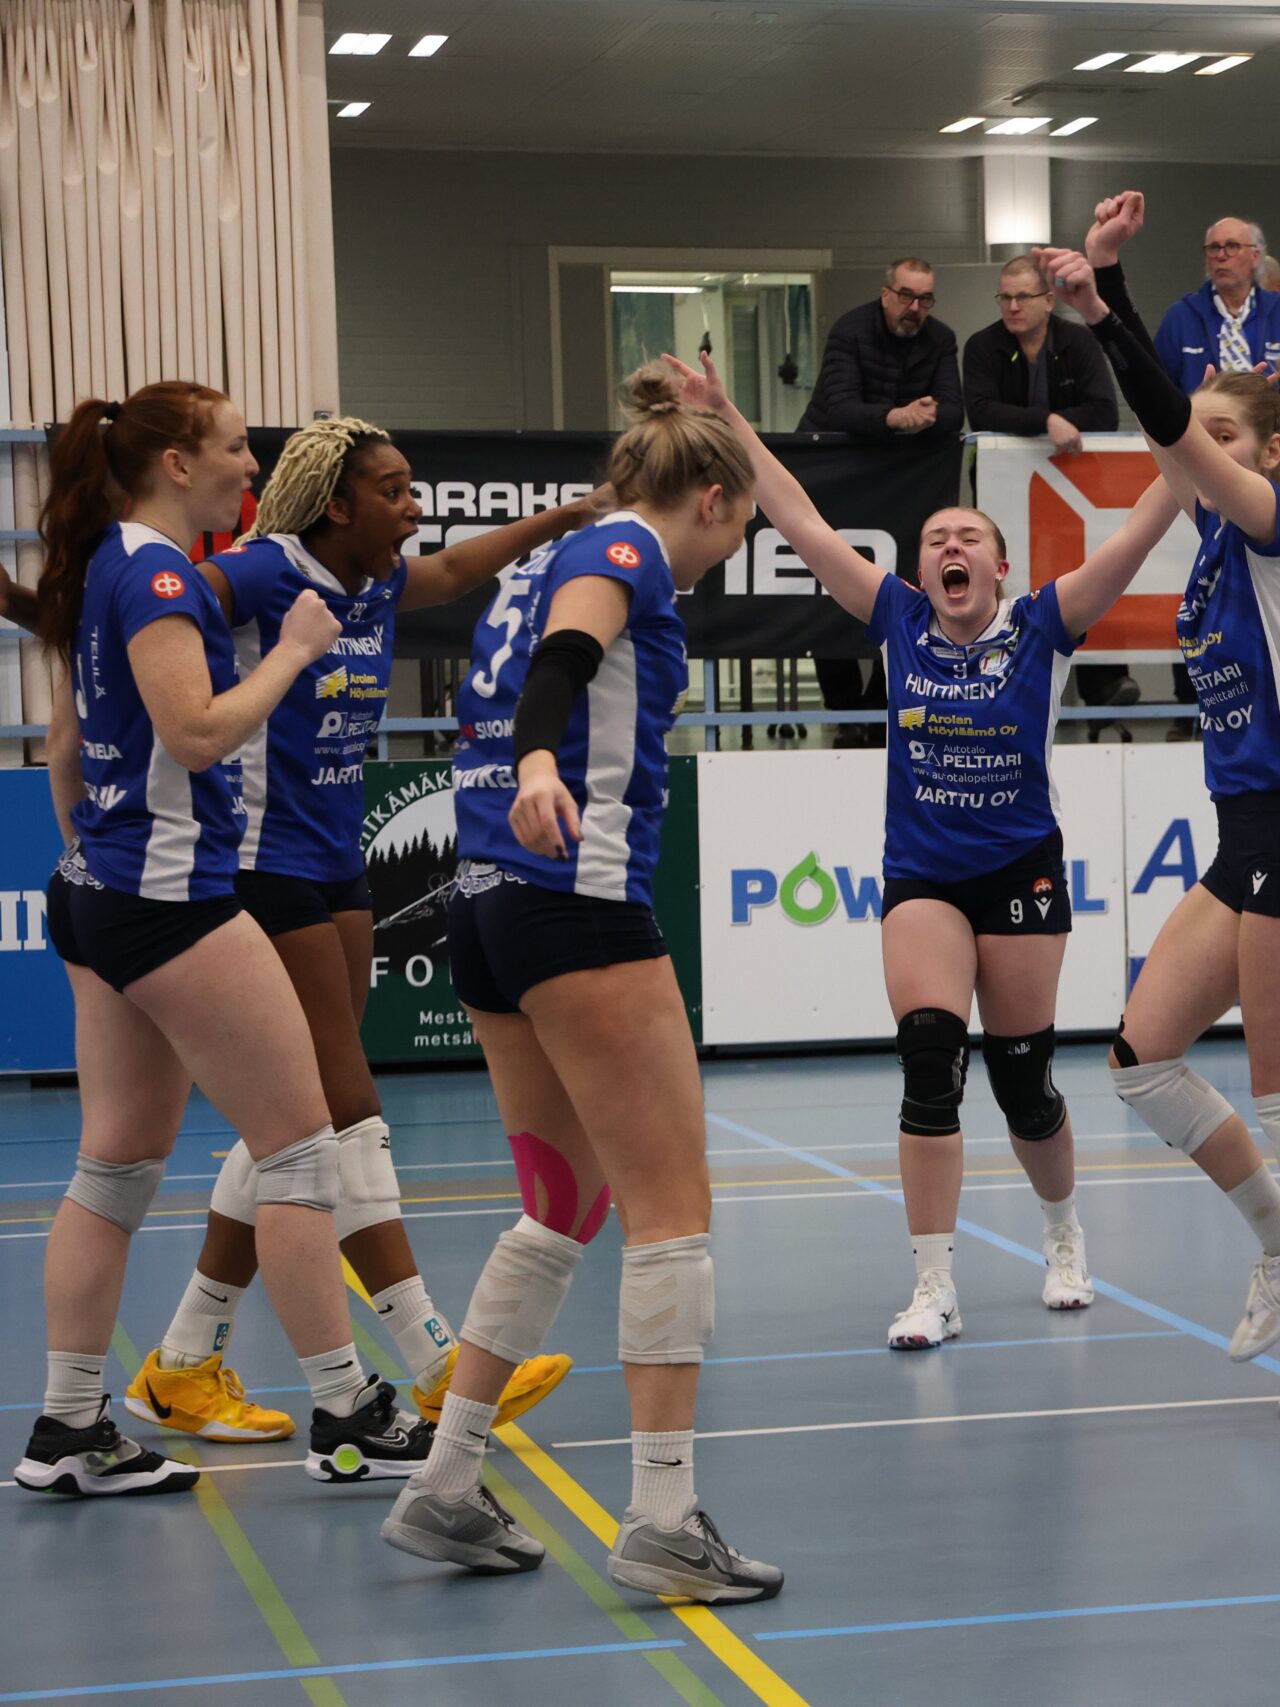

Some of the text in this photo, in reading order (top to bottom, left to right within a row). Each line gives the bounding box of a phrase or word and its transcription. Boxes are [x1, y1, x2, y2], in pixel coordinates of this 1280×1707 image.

[471, 579, 532, 699] 5
[905, 673, 996, 700] HUITTINEN
[928, 713, 973, 725] Arolan
[1226, 704, 1253, 729] OY
[928, 725, 1018, 737] Höyläämö Oy
[943, 744, 986, 755] Autotalo
[943, 753, 1022, 769] PELTTARI
[990, 789, 1020, 807] OY
[1009, 898, 1024, 924] 9
